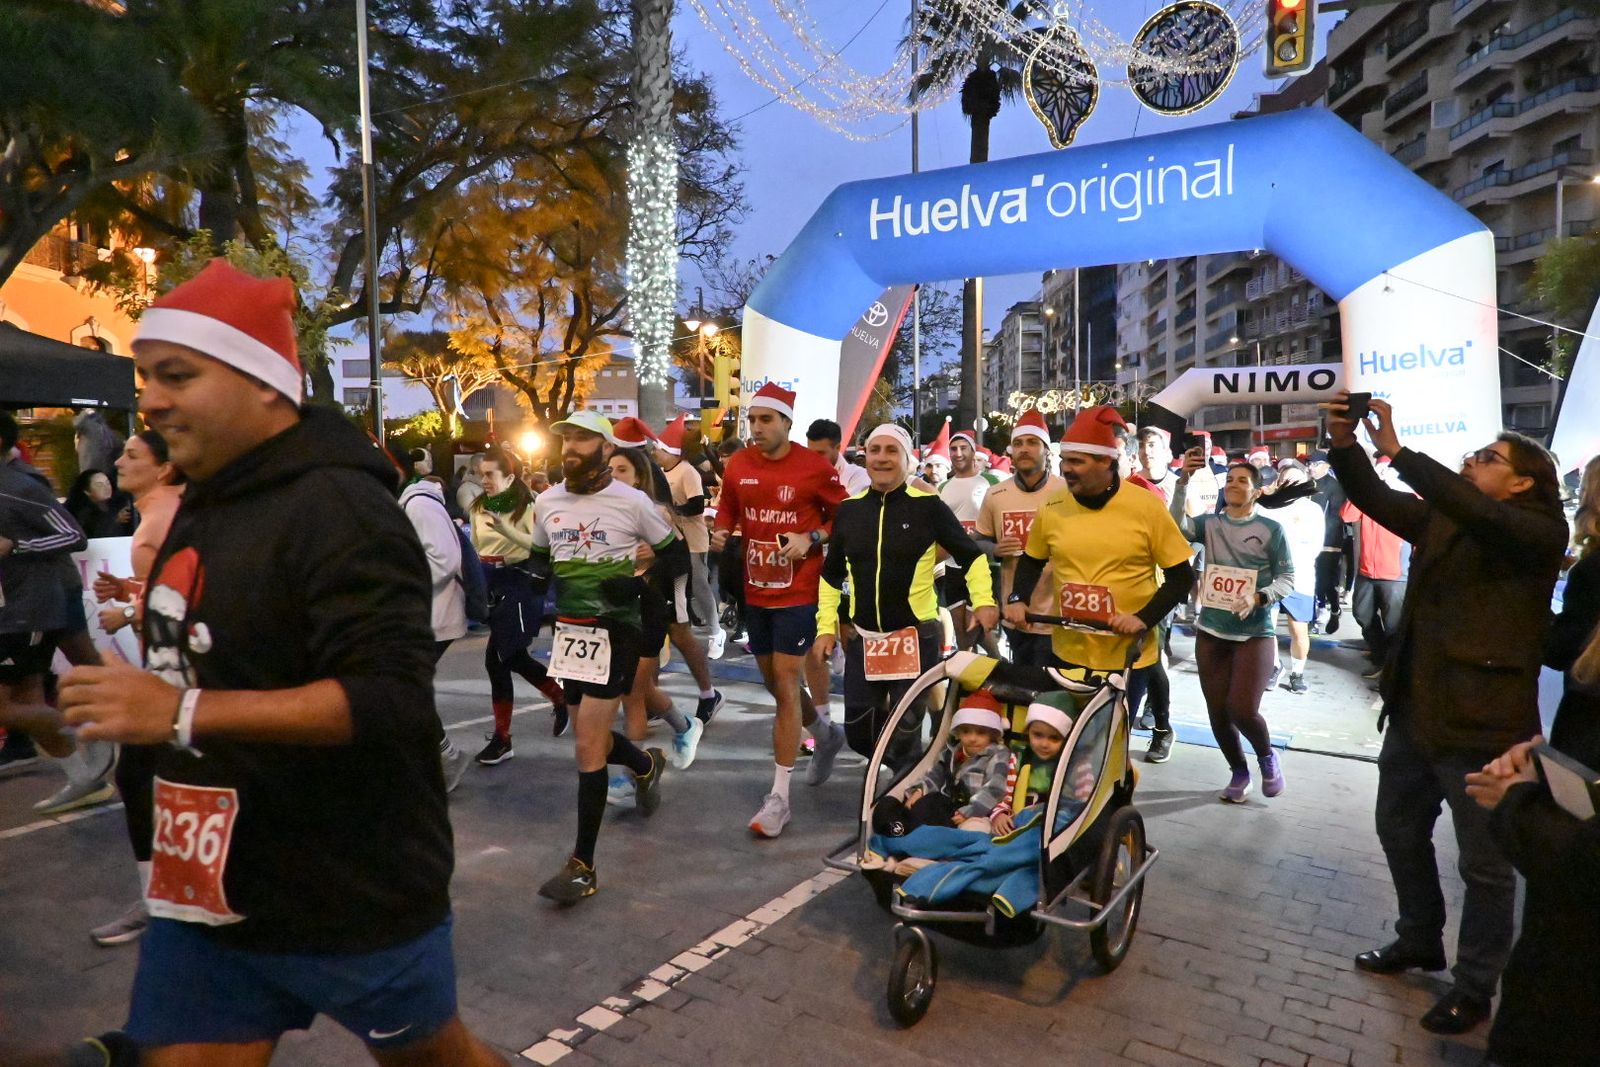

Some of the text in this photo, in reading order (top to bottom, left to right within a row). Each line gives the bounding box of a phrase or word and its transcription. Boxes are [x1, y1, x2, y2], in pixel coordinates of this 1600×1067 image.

[869, 143, 1234, 240] Huelva original
[851, 325, 880, 350] HUELVA
[1359, 342, 1465, 376] Huelva
[1213, 368, 1336, 394] NIMO
[1400, 420, 1468, 437] HUELVA
[759, 508, 798, 524] CARTAYA
[1213, 576, 1247, 595] 607
[1062, 590, 1112, 613] 2281
[564, 637, 601, 660] 737
[866, 635, 915, 657] 2278
